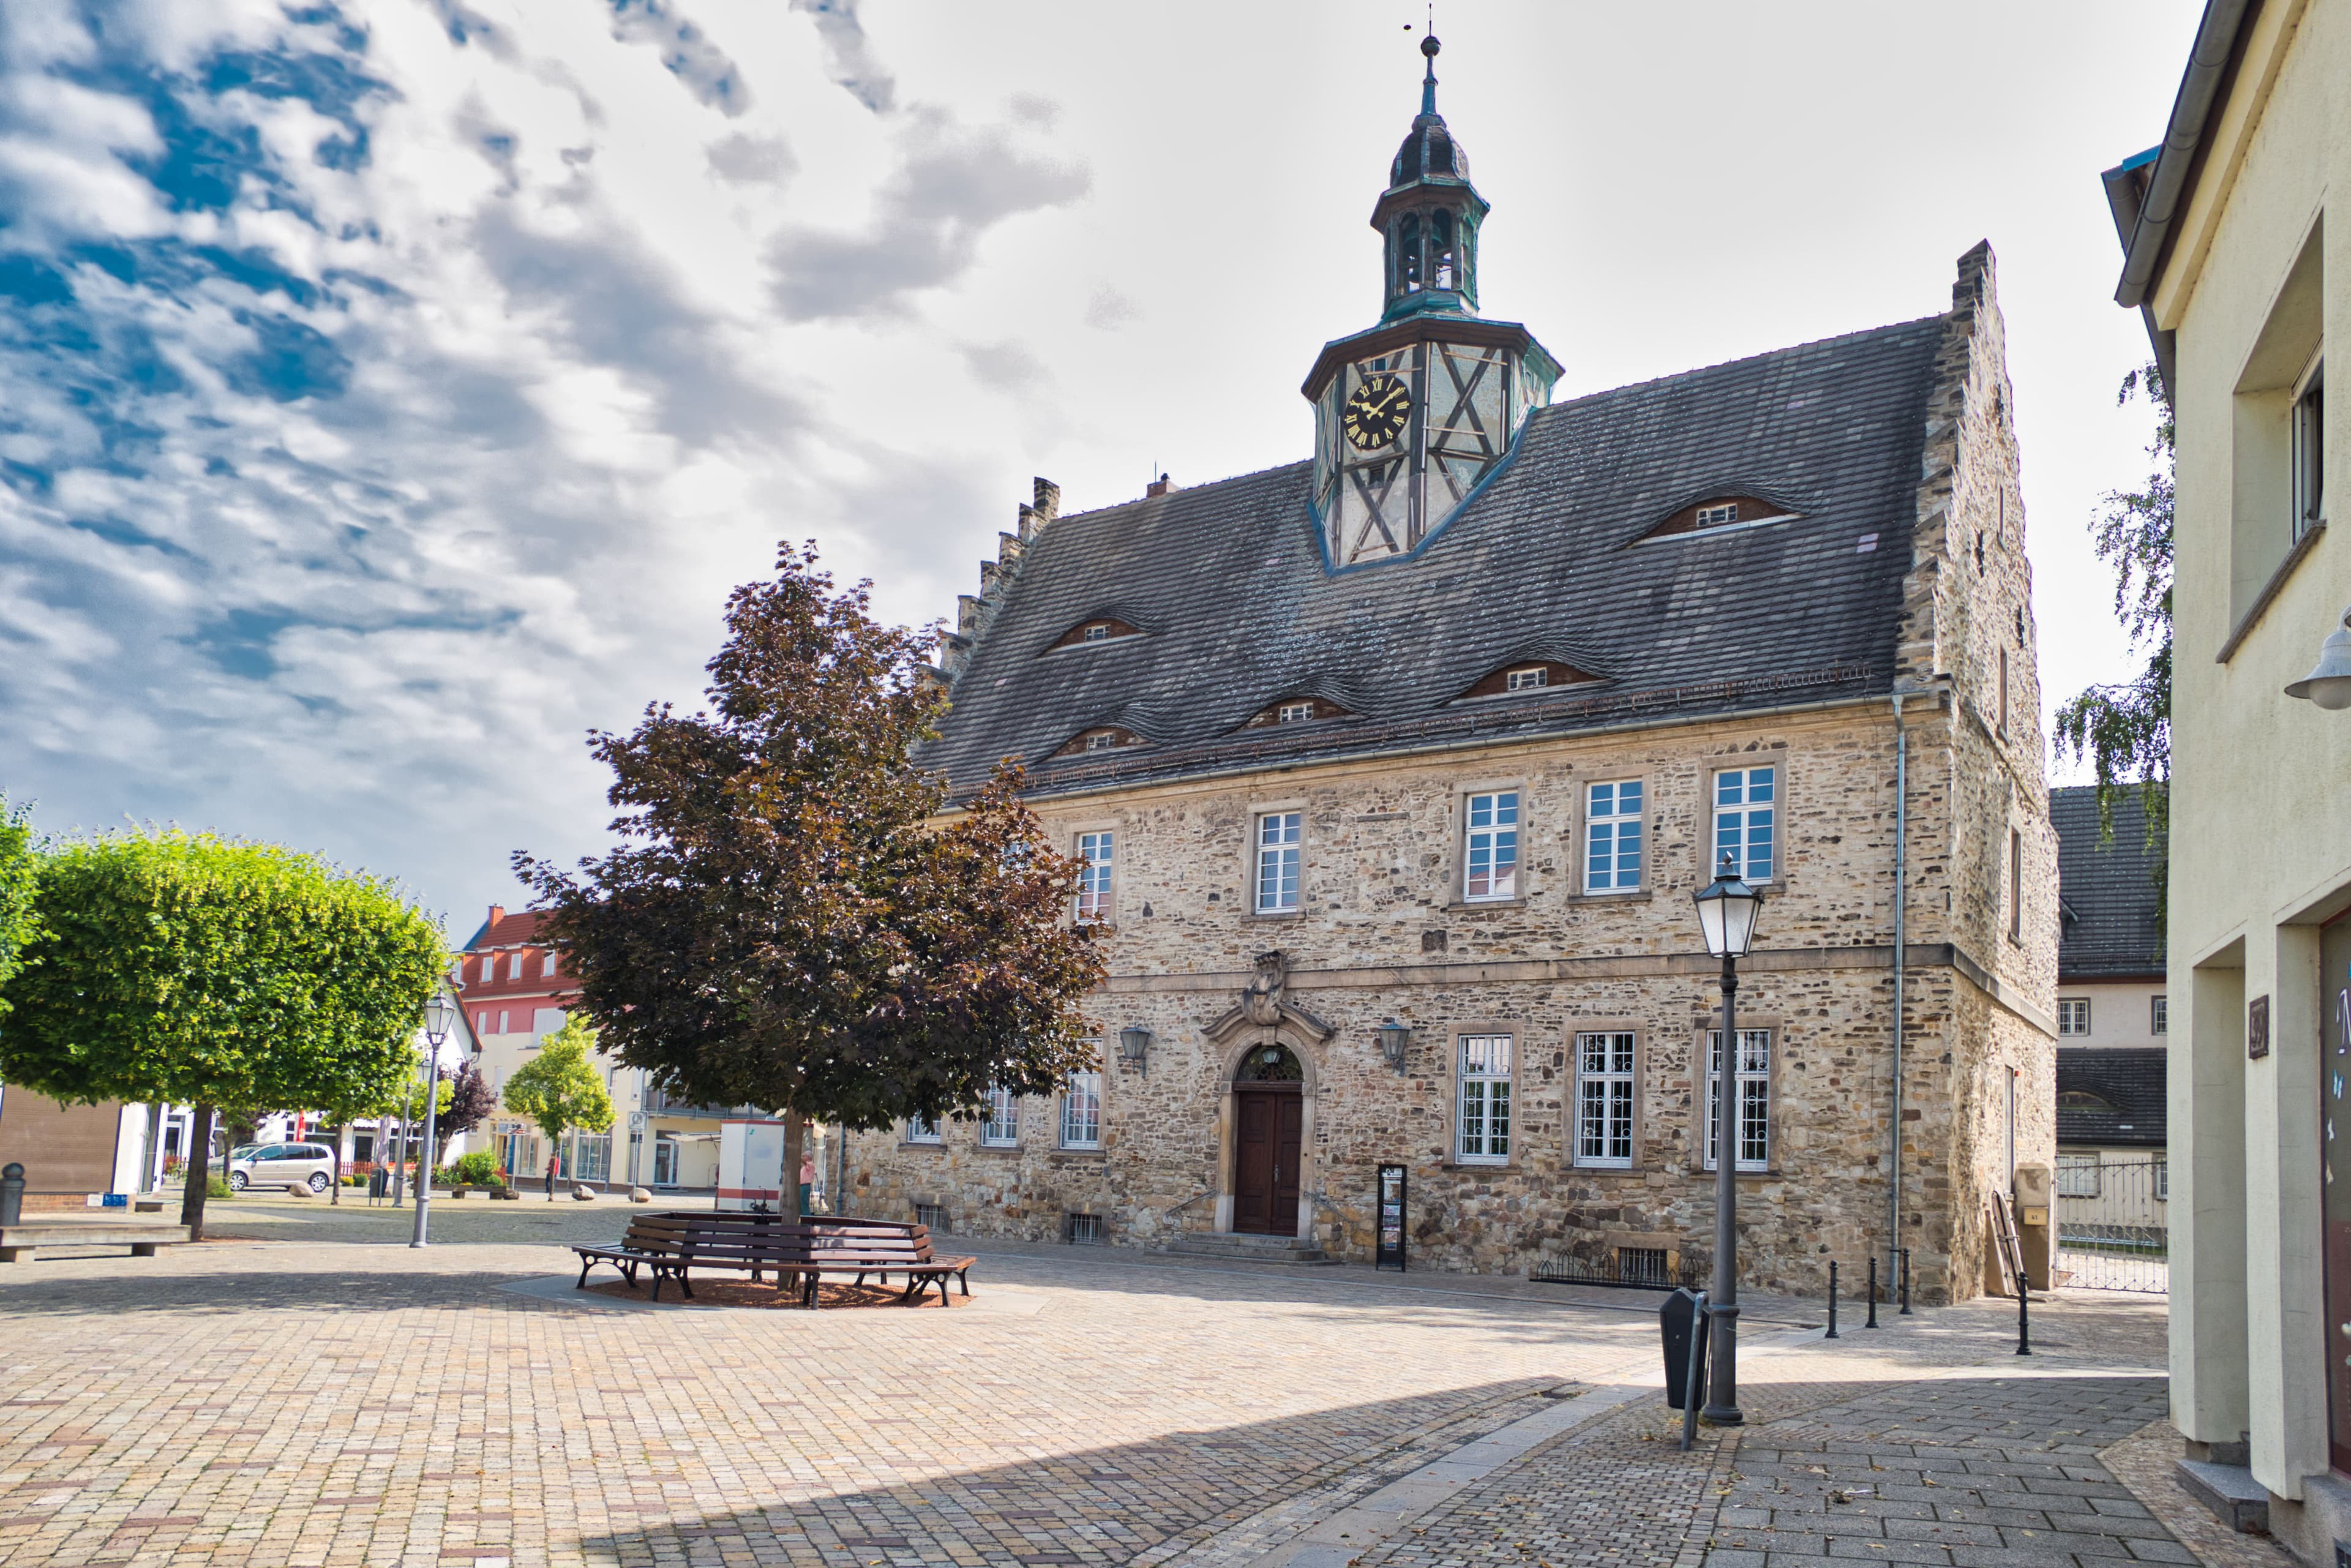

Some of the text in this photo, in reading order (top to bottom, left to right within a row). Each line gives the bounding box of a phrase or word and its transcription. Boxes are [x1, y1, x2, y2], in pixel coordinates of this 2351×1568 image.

[1372, 377, 1383, 392] XII
[1386, 377, 1395, 391] I
[1359, 385, 1370, 399] XI
[1397, 400, 1409, 410] III
[1344, 413, 1357, 424] IX
[1348, 424, 1360, 439] VIII
[1384, 427, 1393, 440] V
[1355, 431, 1368, 447] VII
[1371, 433, 1381, 448] VI
